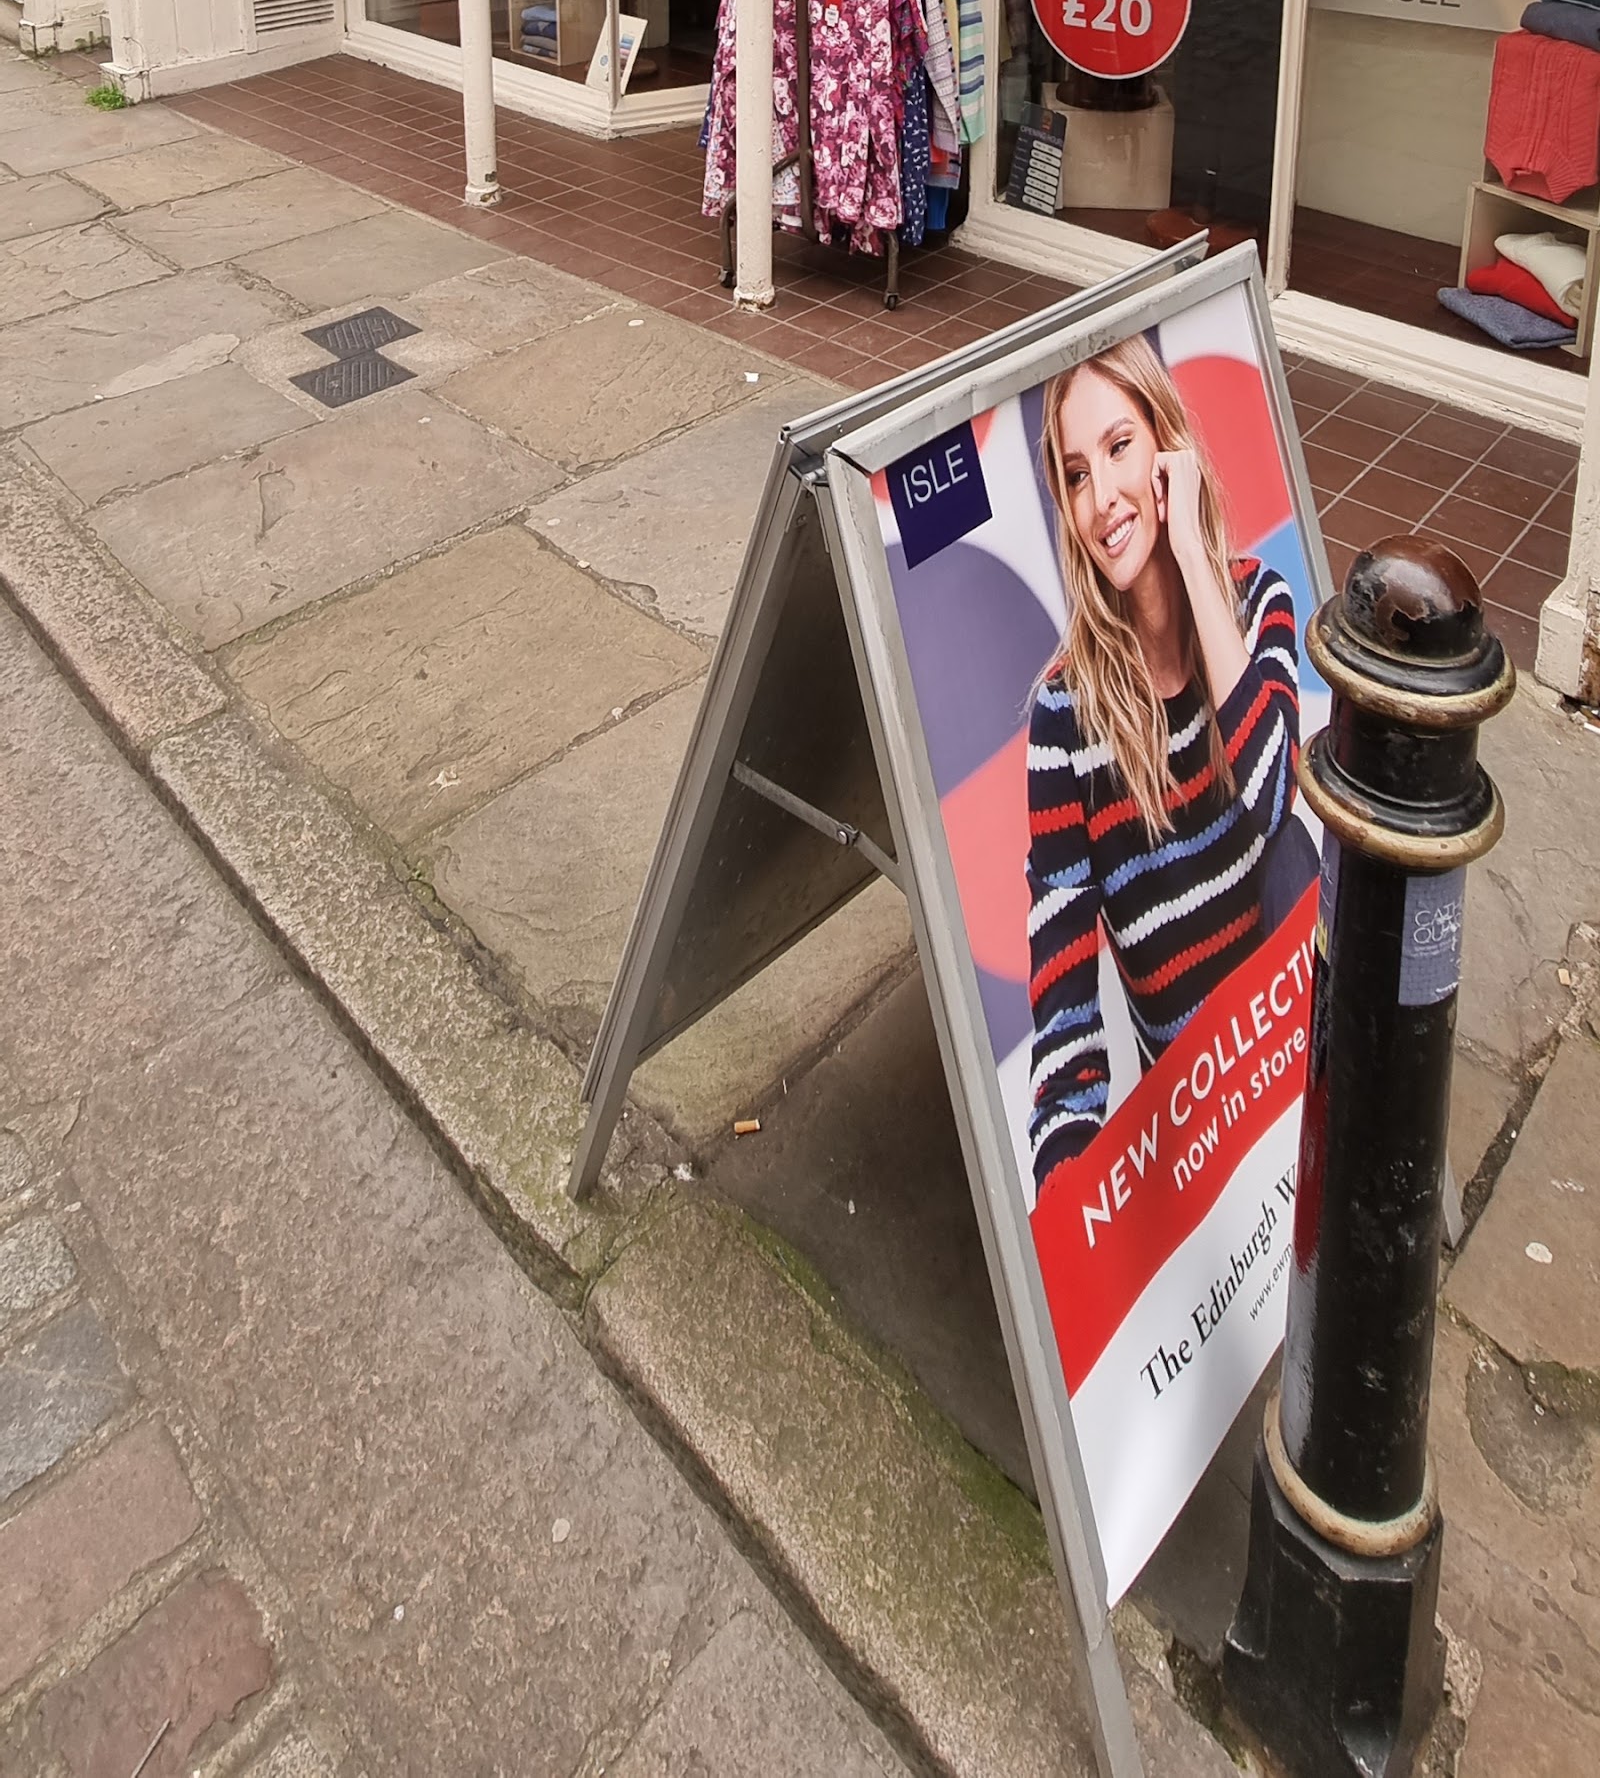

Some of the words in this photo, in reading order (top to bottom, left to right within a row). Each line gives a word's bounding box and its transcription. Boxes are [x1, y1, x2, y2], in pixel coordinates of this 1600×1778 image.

[902, 443, 969, 509] ISLE
[1081, 1112, 1159, 1250] NEW
[1169, 924, 1317, 1127] COLLECTI
[1172, 1115, 1220, 1192] now
[1220, 1089, 1247, 1129] in
[1250, 1027, 1307, 1100] store
[1139, 1337, 1194, 1400] The
[1189, 1200, 1278, 1348] Edinburgh
